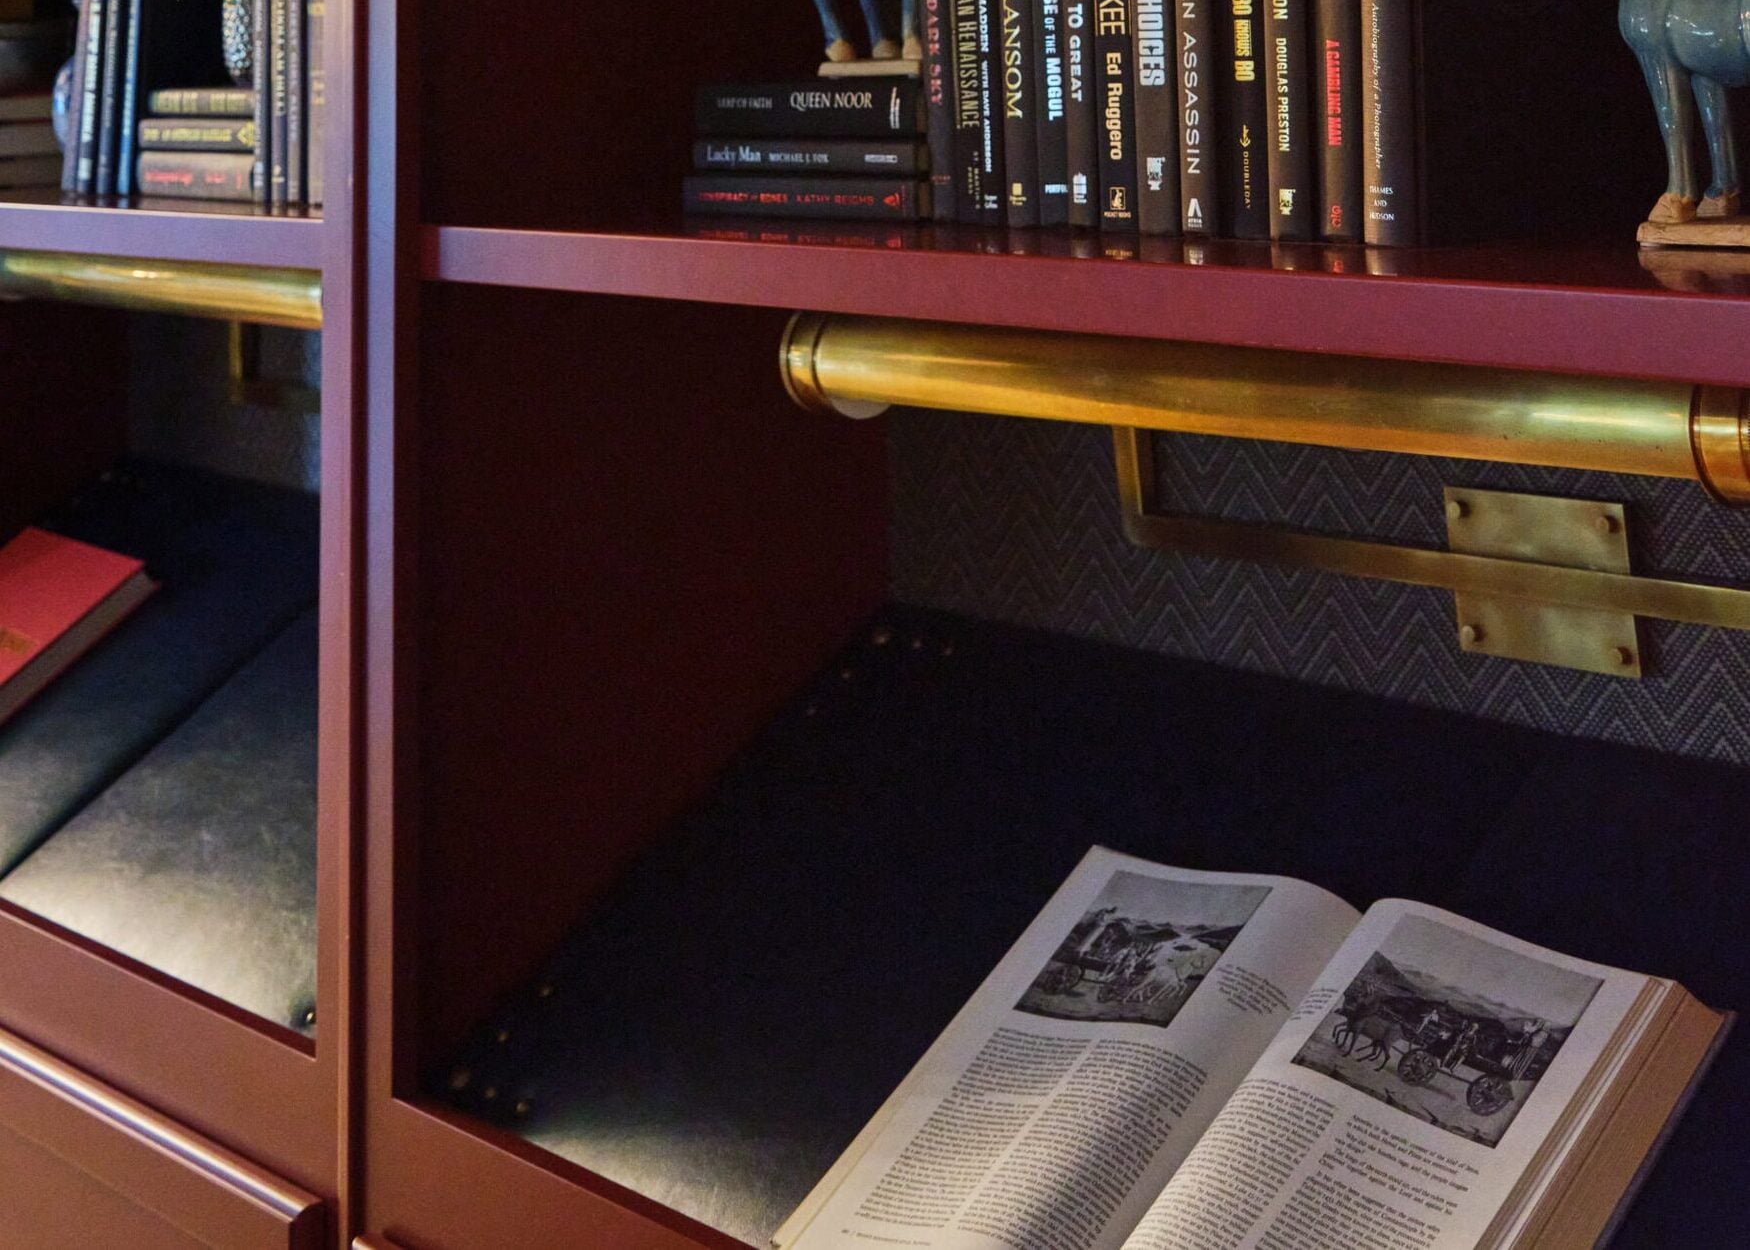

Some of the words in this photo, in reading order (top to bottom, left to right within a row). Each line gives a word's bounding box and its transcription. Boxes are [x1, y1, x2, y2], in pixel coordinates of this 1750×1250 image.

[1044, 17, 1056, 31] OF
[1067, 3, 1083, 29] TO
[1045, 34, 1057, 54] THE
[1234, 19, 1253, 57] KNOWS
[1325, 39, 1340, 49] A
[1371, 3, 1381, 76] Autobiography
[957, 21, 980, 129] RENAISSANCE
[980, 60, 989, 88] WITH
[1069, 35, 1082, 102] GREAT
[1106, 52, 1121, 75] Ed
[1234, 60, 1255, 81] BO
[1275, 37, 1289, 93] DOUGLAS
[930, 63, 942, 105] SKY
[1046, 57, 1063, 121] MOGUL
[1326, 51, 1342, 114] GAMBLING
[1372, 78, 1382, 91] of
[790, 92, 830, 111] QUEEN
[834, 91, 873, 109] NOOR
[982, 90, 990, 116] DAVE
[1182, 31, 1201, 174] ASSASSIN
[1105, 82, 1123, 160] Ruggero
[1277, 96, 1290, 152] PRESTON
[1327, 116, 1342, 146] MAN
[1373, 102, 1383, 169] Photographer
[707, 145, 736, 166] Lucky
[738, 146, 761, 162] Man
[769, 152, 804, 163] MICHAEL
[812, 154, 829, 164] FOX
[983, 118, 992, 173] ANDERSON
[1242, 151, 1251, 210] DOUBLEDAY
[796, 193, 830, 203] KATHY
